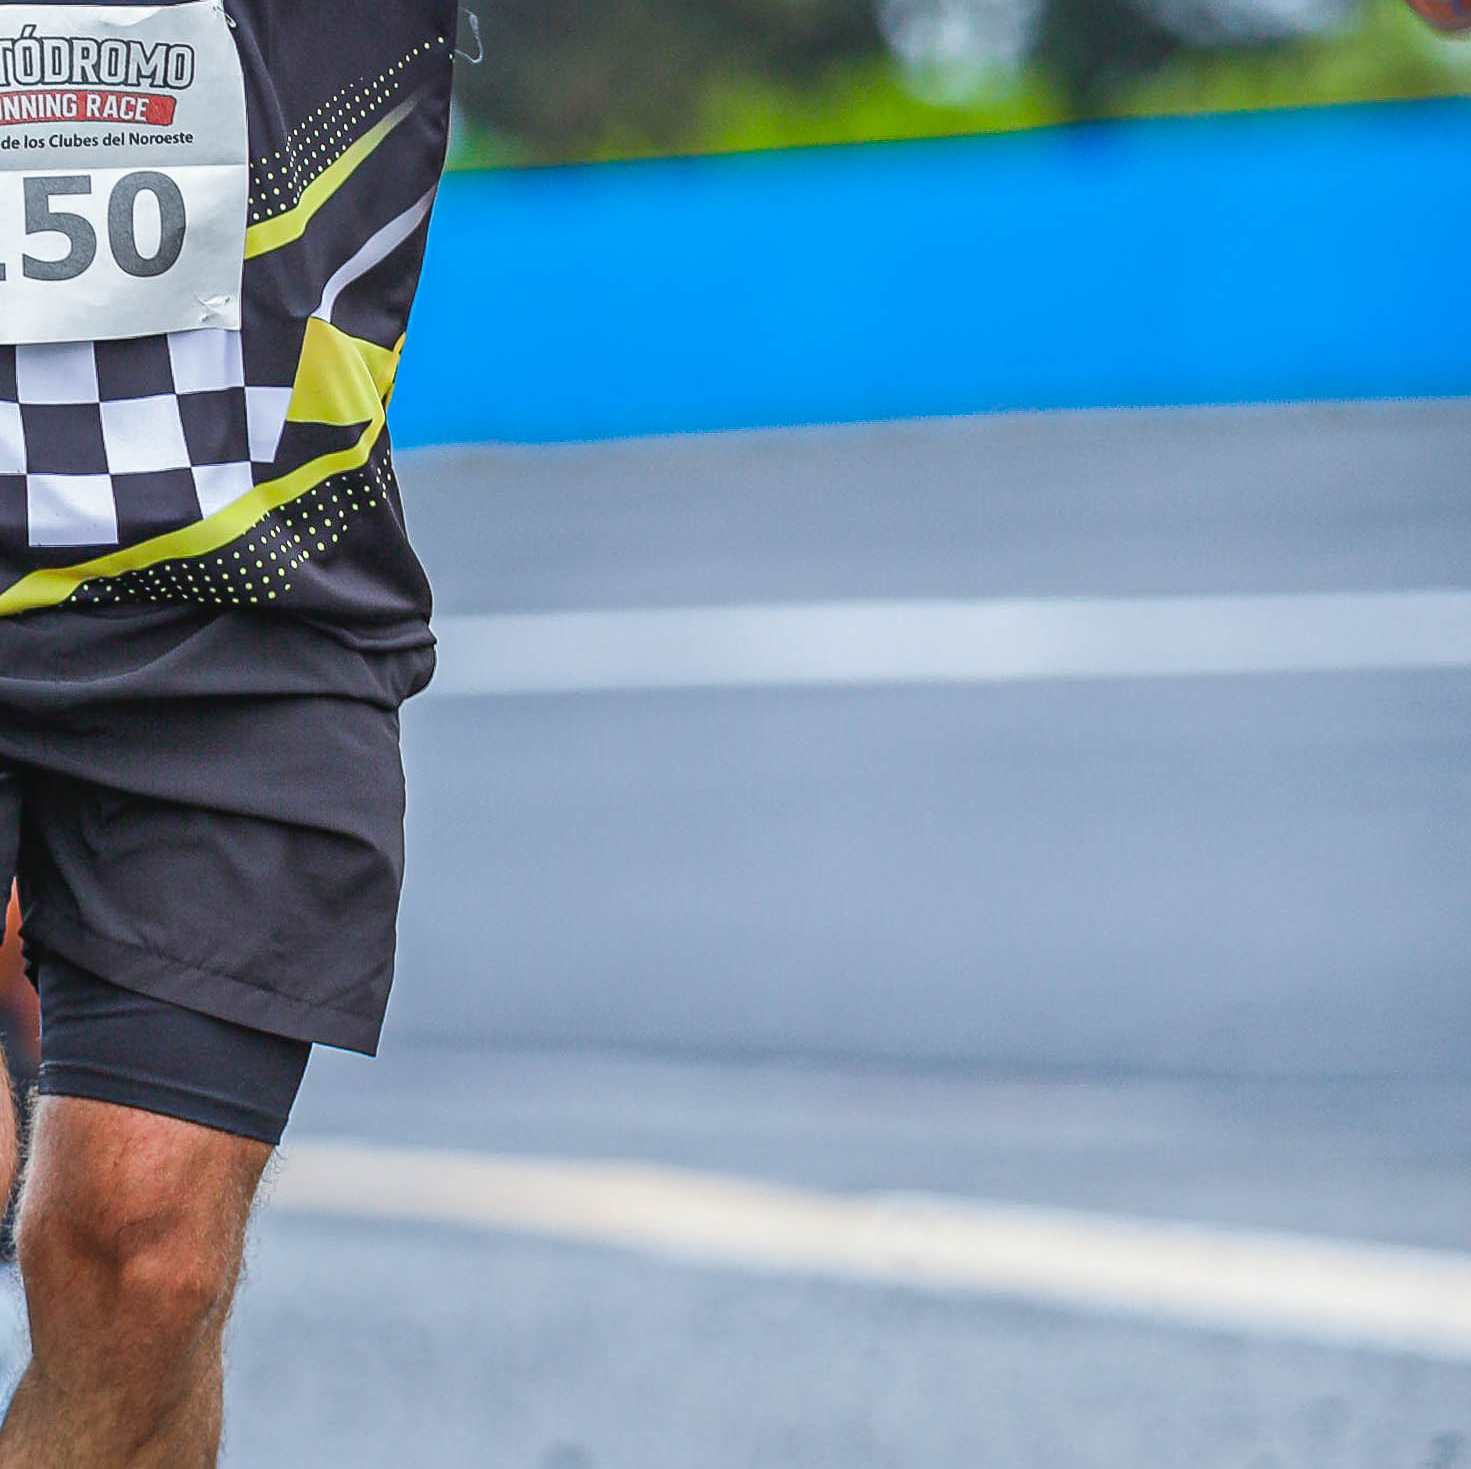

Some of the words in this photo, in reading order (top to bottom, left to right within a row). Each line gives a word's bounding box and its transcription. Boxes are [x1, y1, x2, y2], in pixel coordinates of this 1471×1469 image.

[86, 93, 150, 121] RACE
[1, 135, 20, 150] de
[24, 135, 45, 149] los
[48, 134, 98, 148] Clubes
[103, 132, 125, 146] del
[129, 132, 194, 146] Noroeste
